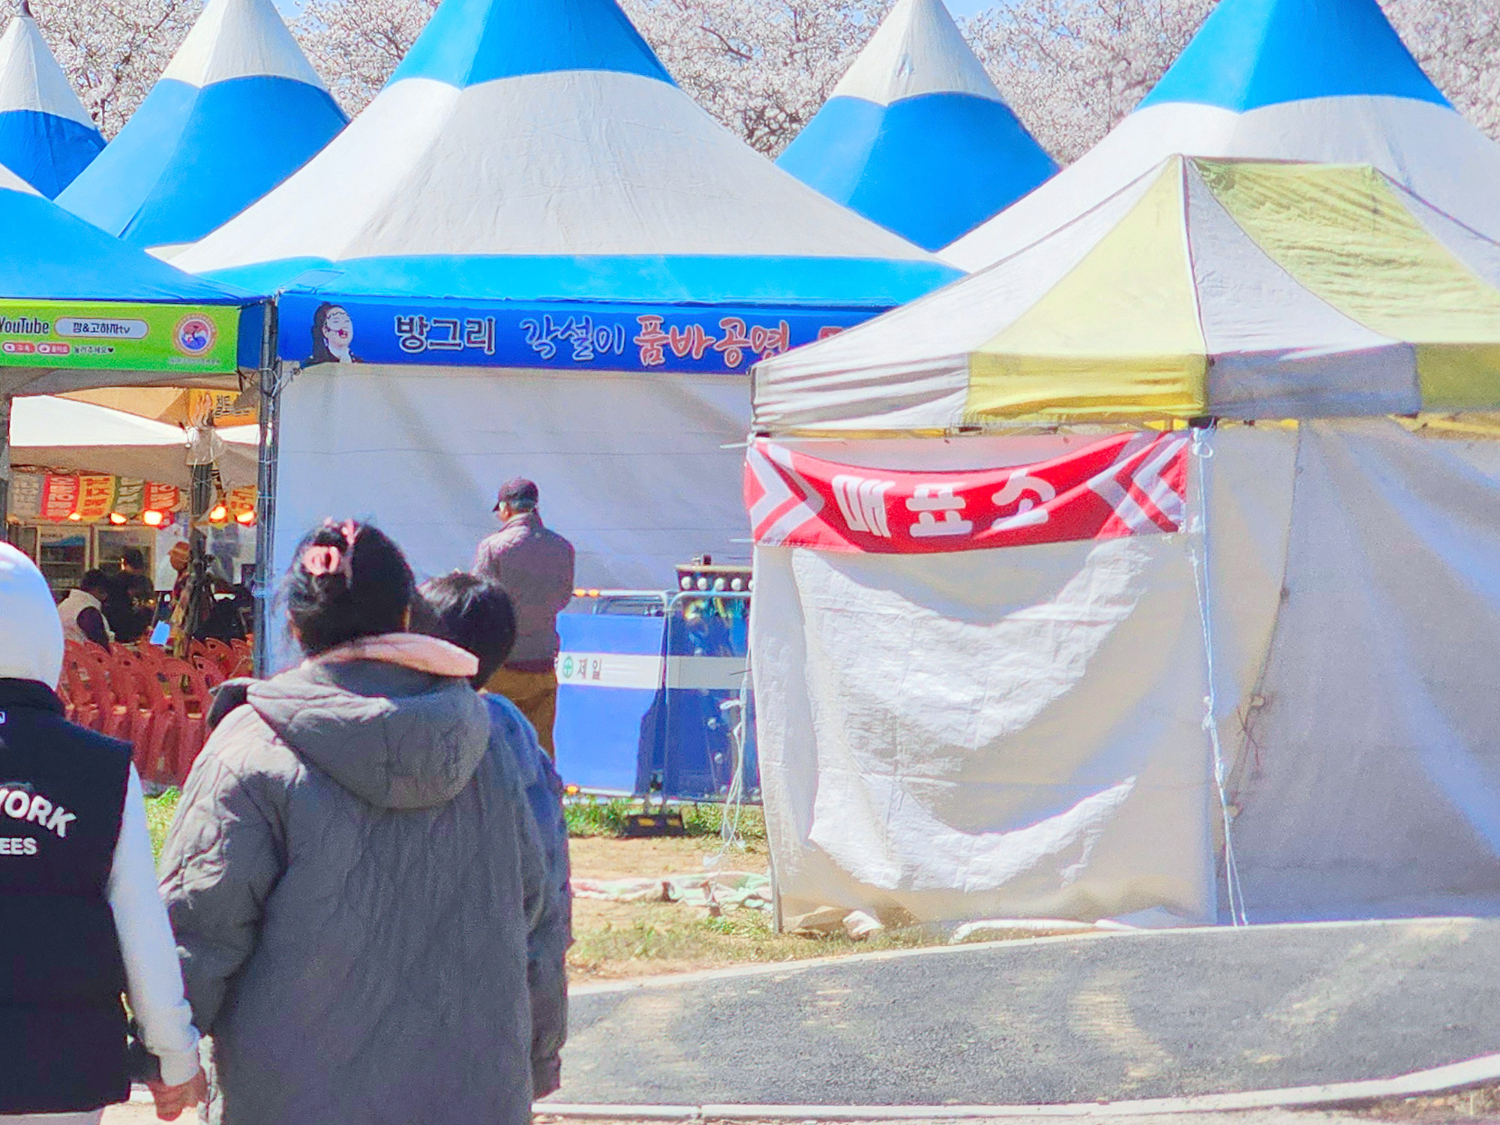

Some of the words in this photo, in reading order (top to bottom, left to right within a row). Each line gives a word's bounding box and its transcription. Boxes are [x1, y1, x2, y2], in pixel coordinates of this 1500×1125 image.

[395, 315, 497, 355] 방그리
[519, 315, 626, 362] 각설이
[832, 469, 1056, 538] 매표소
